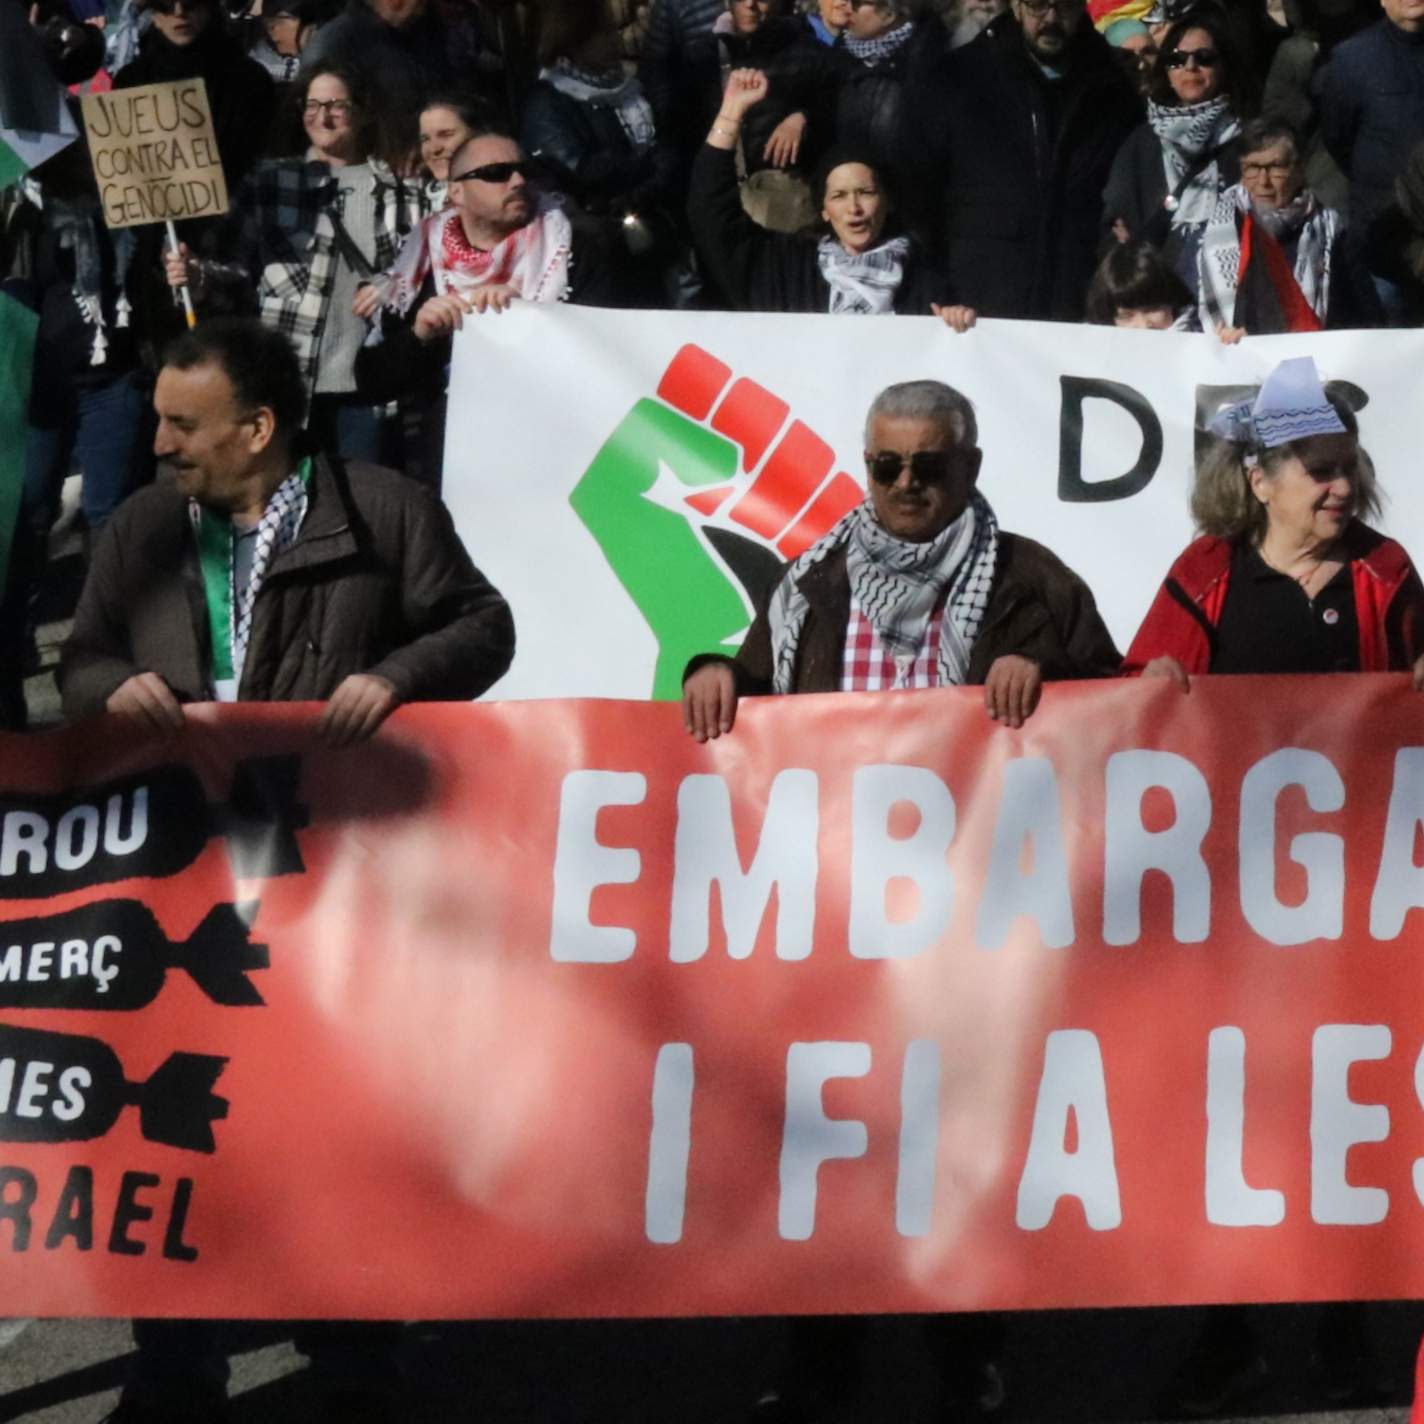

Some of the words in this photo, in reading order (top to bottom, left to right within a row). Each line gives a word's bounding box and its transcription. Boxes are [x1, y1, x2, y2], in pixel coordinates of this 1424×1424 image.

[90, 87, 206, 138] JUEUS
[96, 137, 189, 180] CONTRA
[191, 137, 221, 168] EL
[103, 179, 221, 225] GENOCIDI
[644, 1042, 695, 1245] I
[777, 1037, 941, 1244] FI
[1014, 1028, 1122, 1231] A
